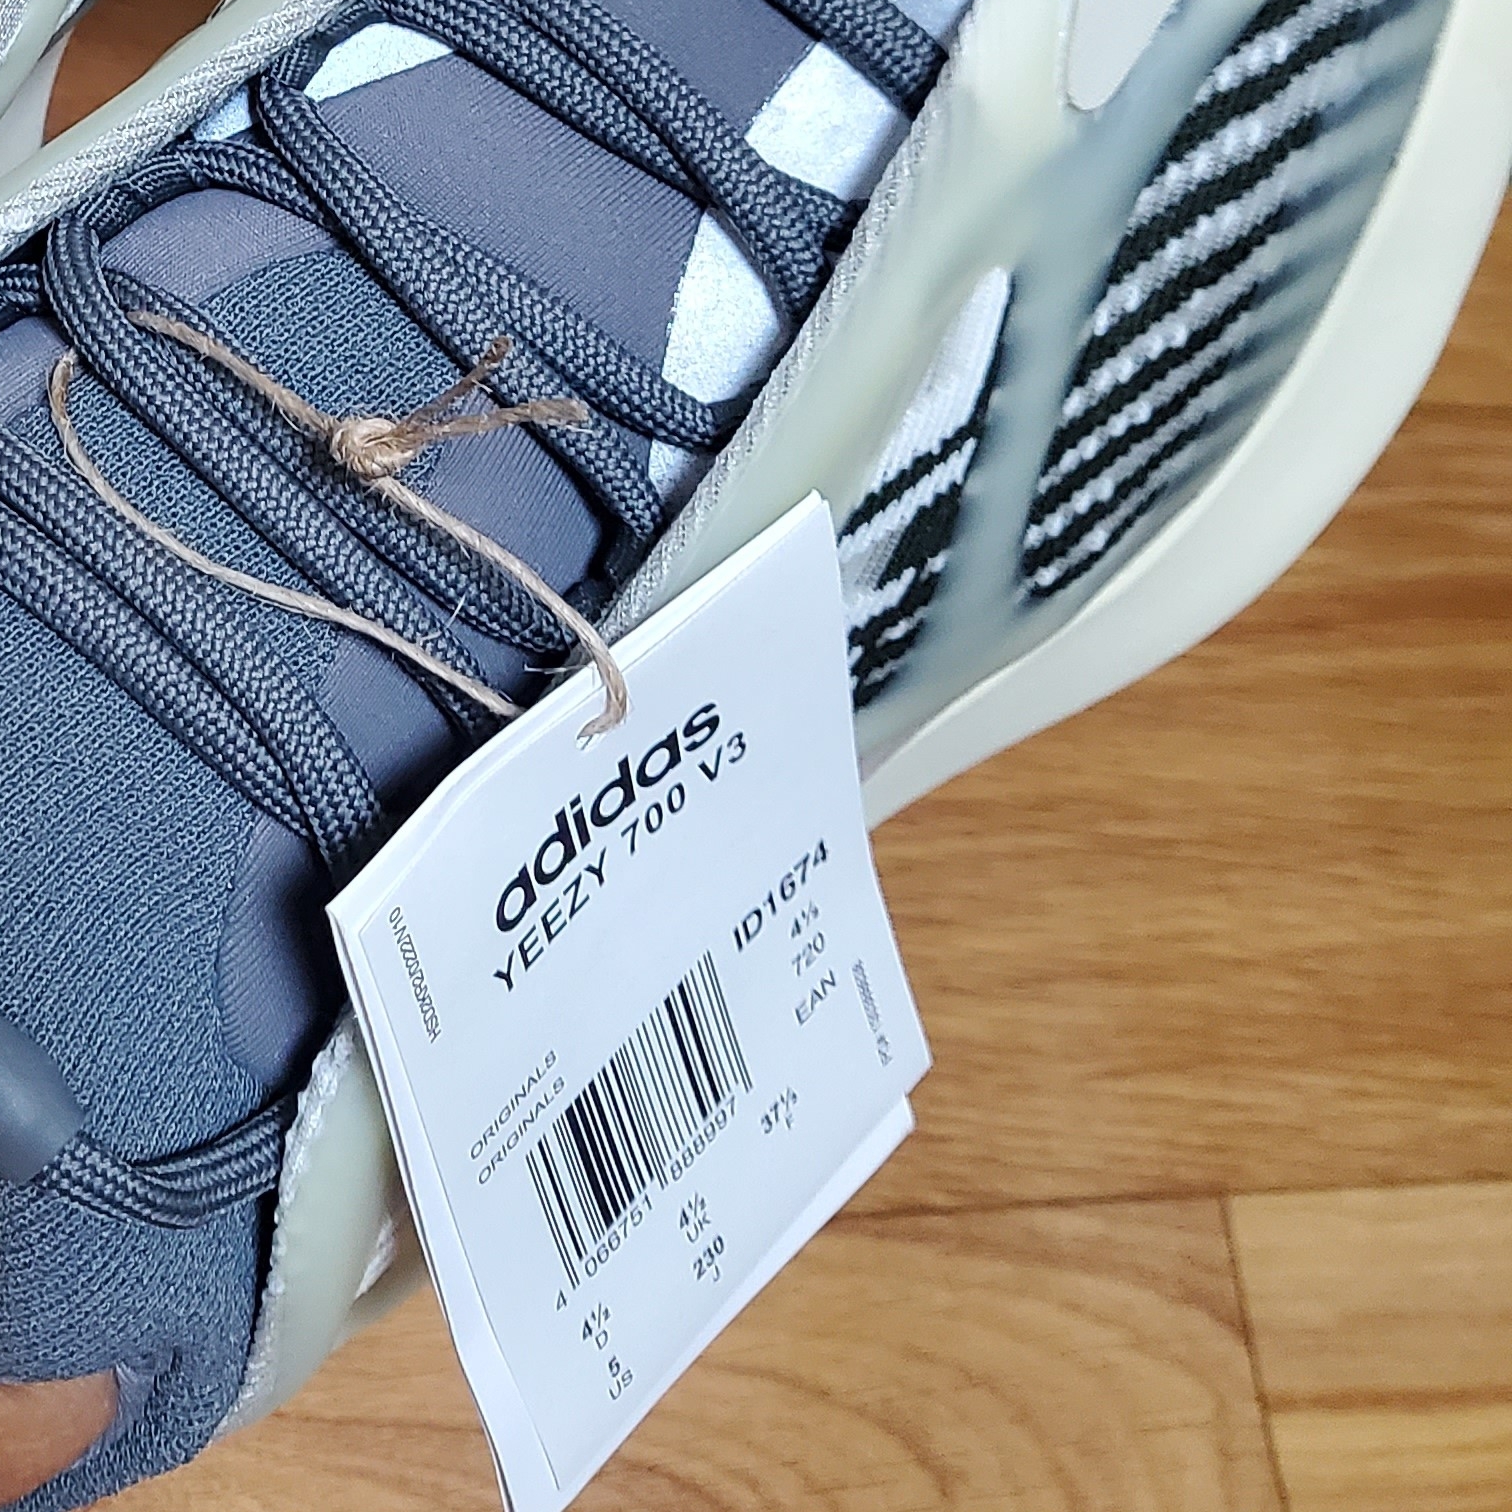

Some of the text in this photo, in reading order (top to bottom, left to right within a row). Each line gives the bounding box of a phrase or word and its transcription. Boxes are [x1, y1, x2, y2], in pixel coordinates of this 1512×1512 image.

[496, 703, 720, 932] adidas
[493, 732, 747, 992] YEEZY 700 V3
[733, 838, 828, 952] ID1674
[792, 932, 826, 976] 720
[794, 968, 837, 1026] EAN
[470, 1050, 557, 1160] ORIGINALS
[478, 1076, 565, 1185] ORIGINALS
[555, 1096, 736, 1311] 4 066751 888997
[687, 1211, 712, 1244] UK
[693, 1236, 725, 1280] 230
[595, 1330, 609, 1351] D
[608, 1355, 620, 1378] 5
[608, 1369, 633, 1401] US
